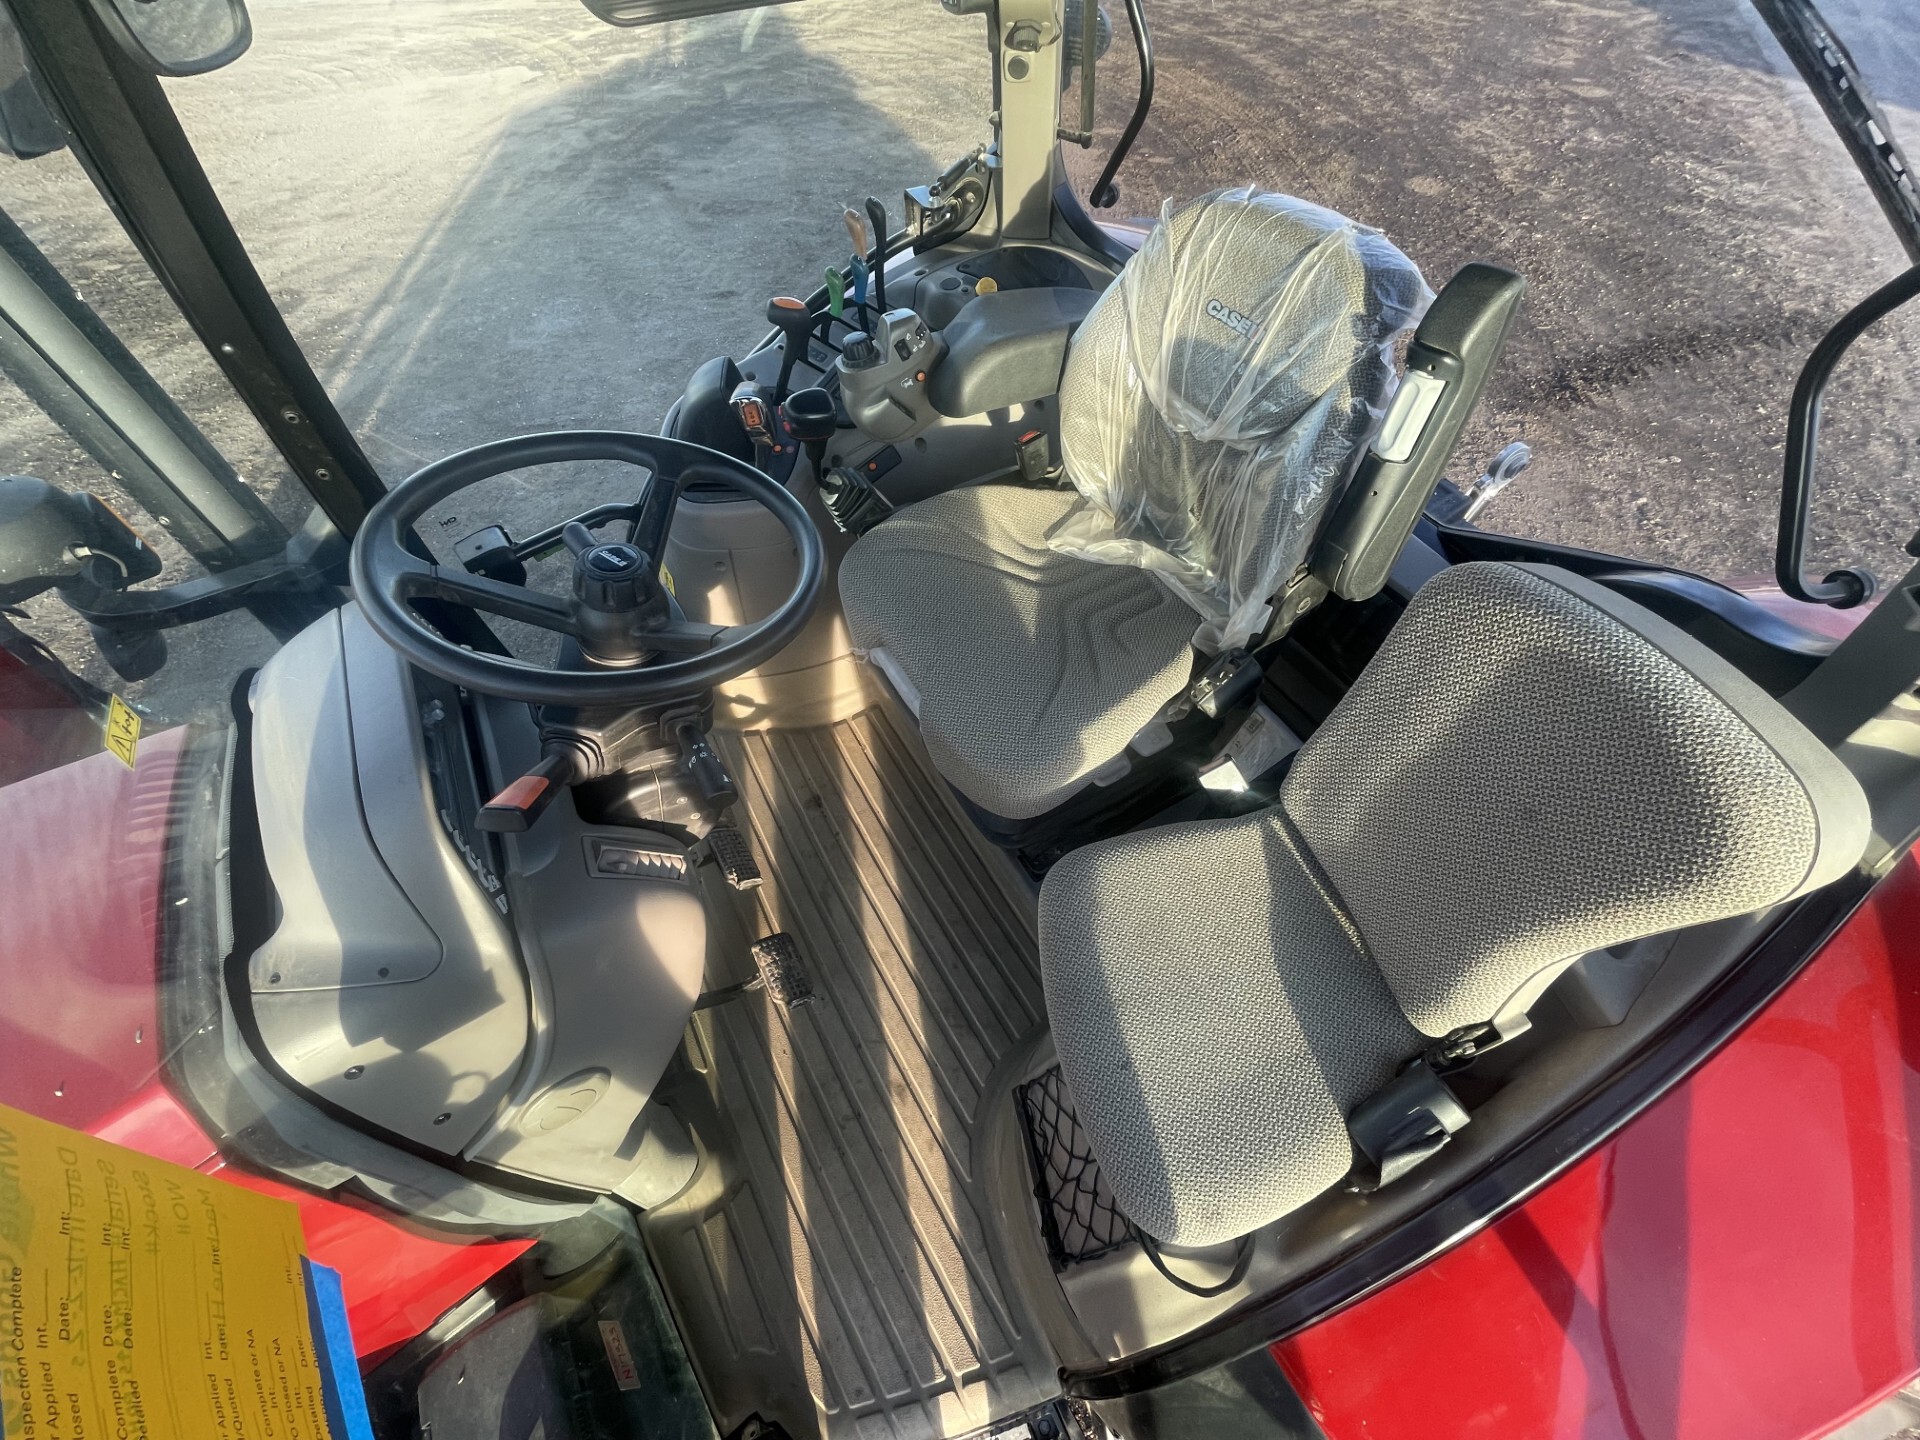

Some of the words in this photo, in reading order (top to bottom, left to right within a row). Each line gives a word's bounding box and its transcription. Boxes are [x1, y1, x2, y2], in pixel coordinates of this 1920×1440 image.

[1206, 299, 1252, 335] CASE
[59, 1211, 71, 1236] Int:
[101, 1222, 111, 1246] Int:
[121, 1227, 131, 1250] Int:
[9, 1267, 25, 1351] Complete
[58, 1297, 70, 1341] Date:
[102, 1304, 114, 1347] Date:
[122, 1307, 134, 1349] Date:
[246, 1328, 256, 1349] NA
[250, 1352, 259, 1366] or
[272, 1337, 282, 1356] NA
[296, 1335, 308, 1368] Date:
[277, 1360, 285, 1373] or
[40, 1361, 60, 1430] Applied
[106, 1360, 128, 1440] Complete
[207, 1373, 226, 1429] Applied
[253, 1369, 274, 1437] Complete
[279, 1376, 295, 1424] Closed
[306, 1386, 323, 1440] Detailed
